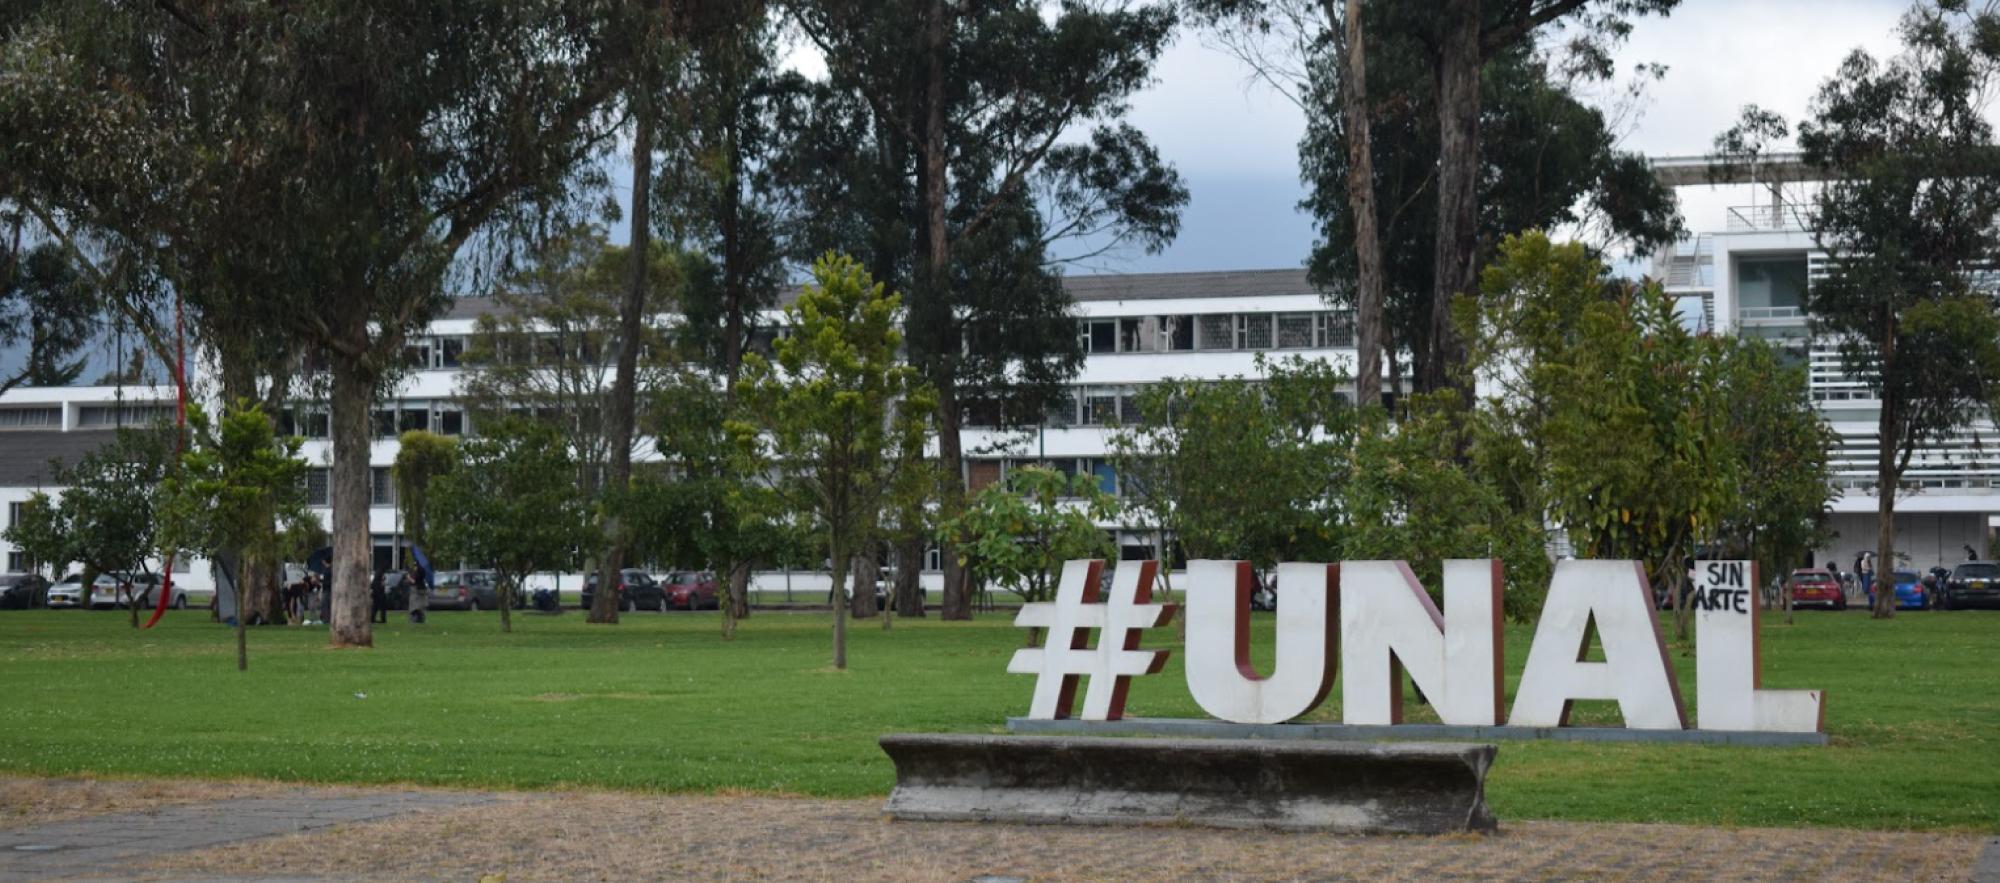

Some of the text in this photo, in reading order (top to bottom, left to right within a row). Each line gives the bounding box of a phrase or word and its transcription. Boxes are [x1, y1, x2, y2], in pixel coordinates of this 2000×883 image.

[1707, 561, 1744, 588] SIN
[1694, 585, 1750, 615] ARTE
[1007, 558, 1825, 733] #UNAL
